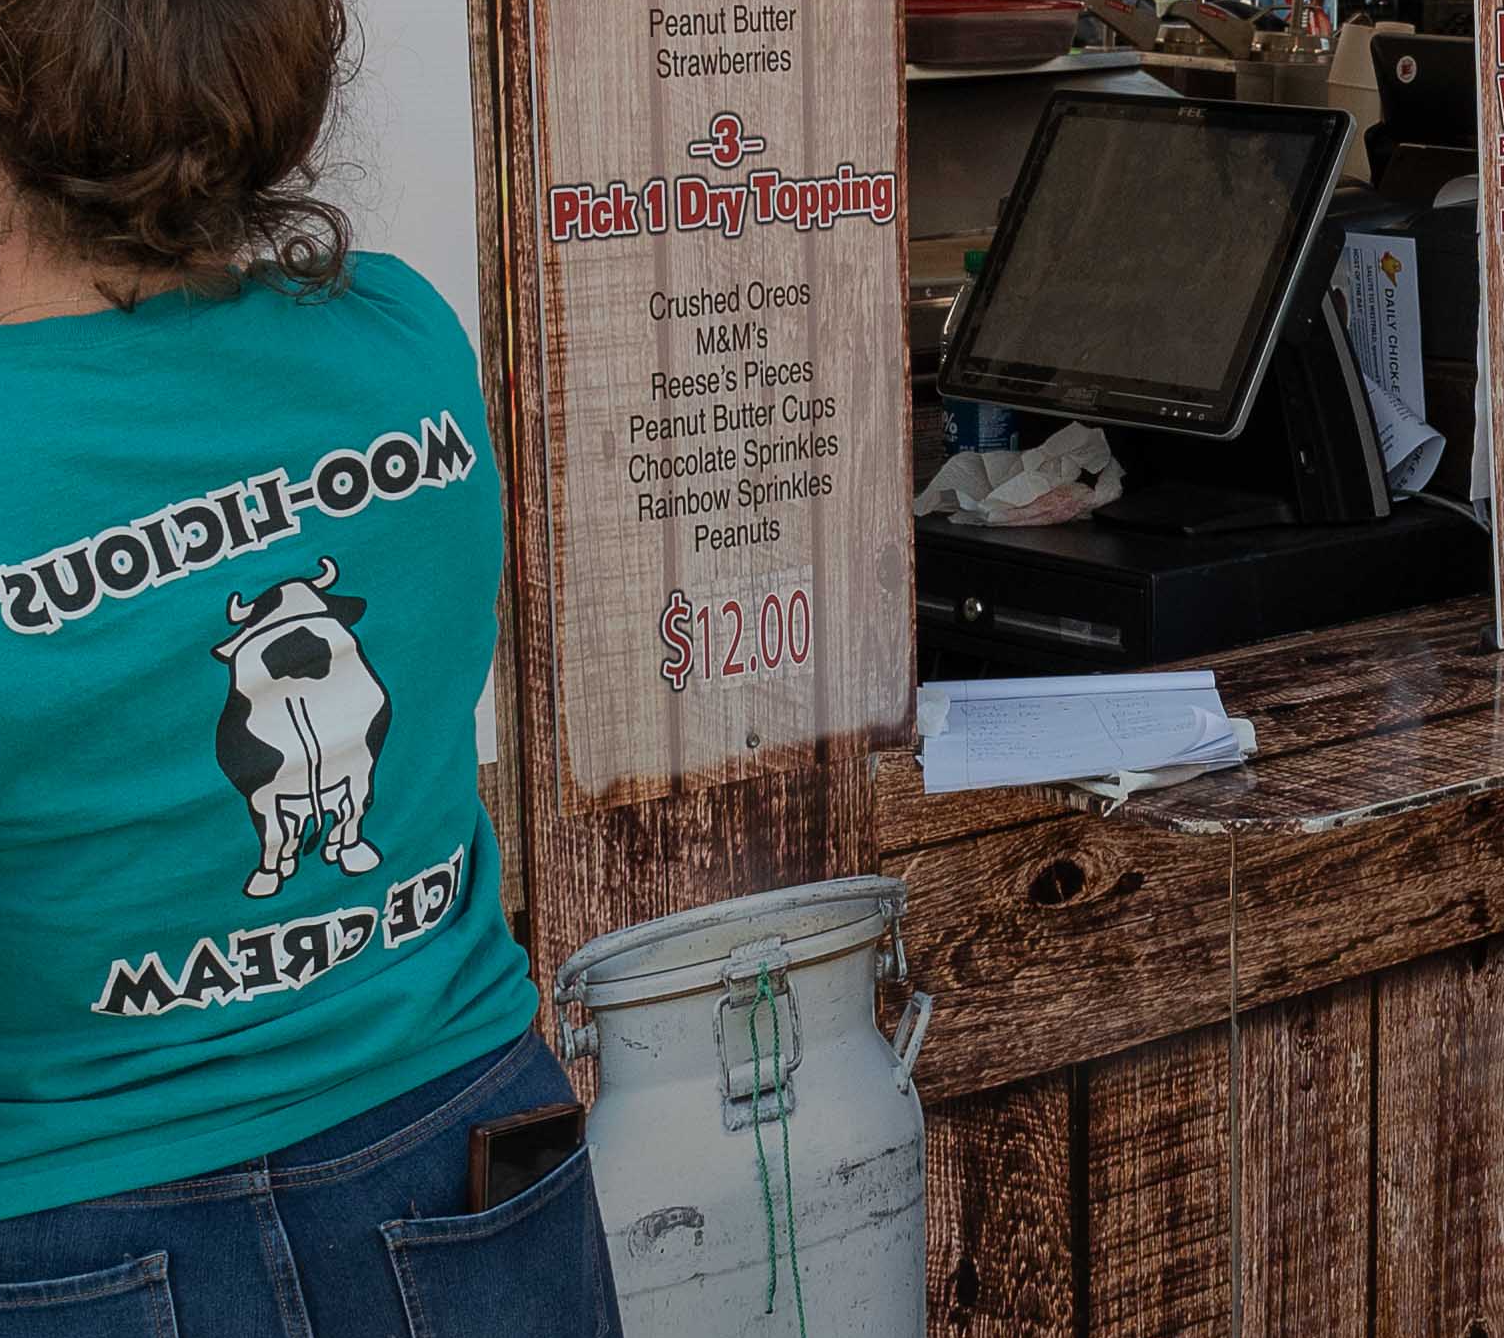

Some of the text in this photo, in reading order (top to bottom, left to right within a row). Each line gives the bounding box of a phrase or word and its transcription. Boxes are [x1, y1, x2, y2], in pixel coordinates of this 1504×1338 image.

[650, 281, 810, 322] Crushed Oreos
[1385, 289, 1395, 330] DAILY
[659, 588, 811, 691] $12.00
